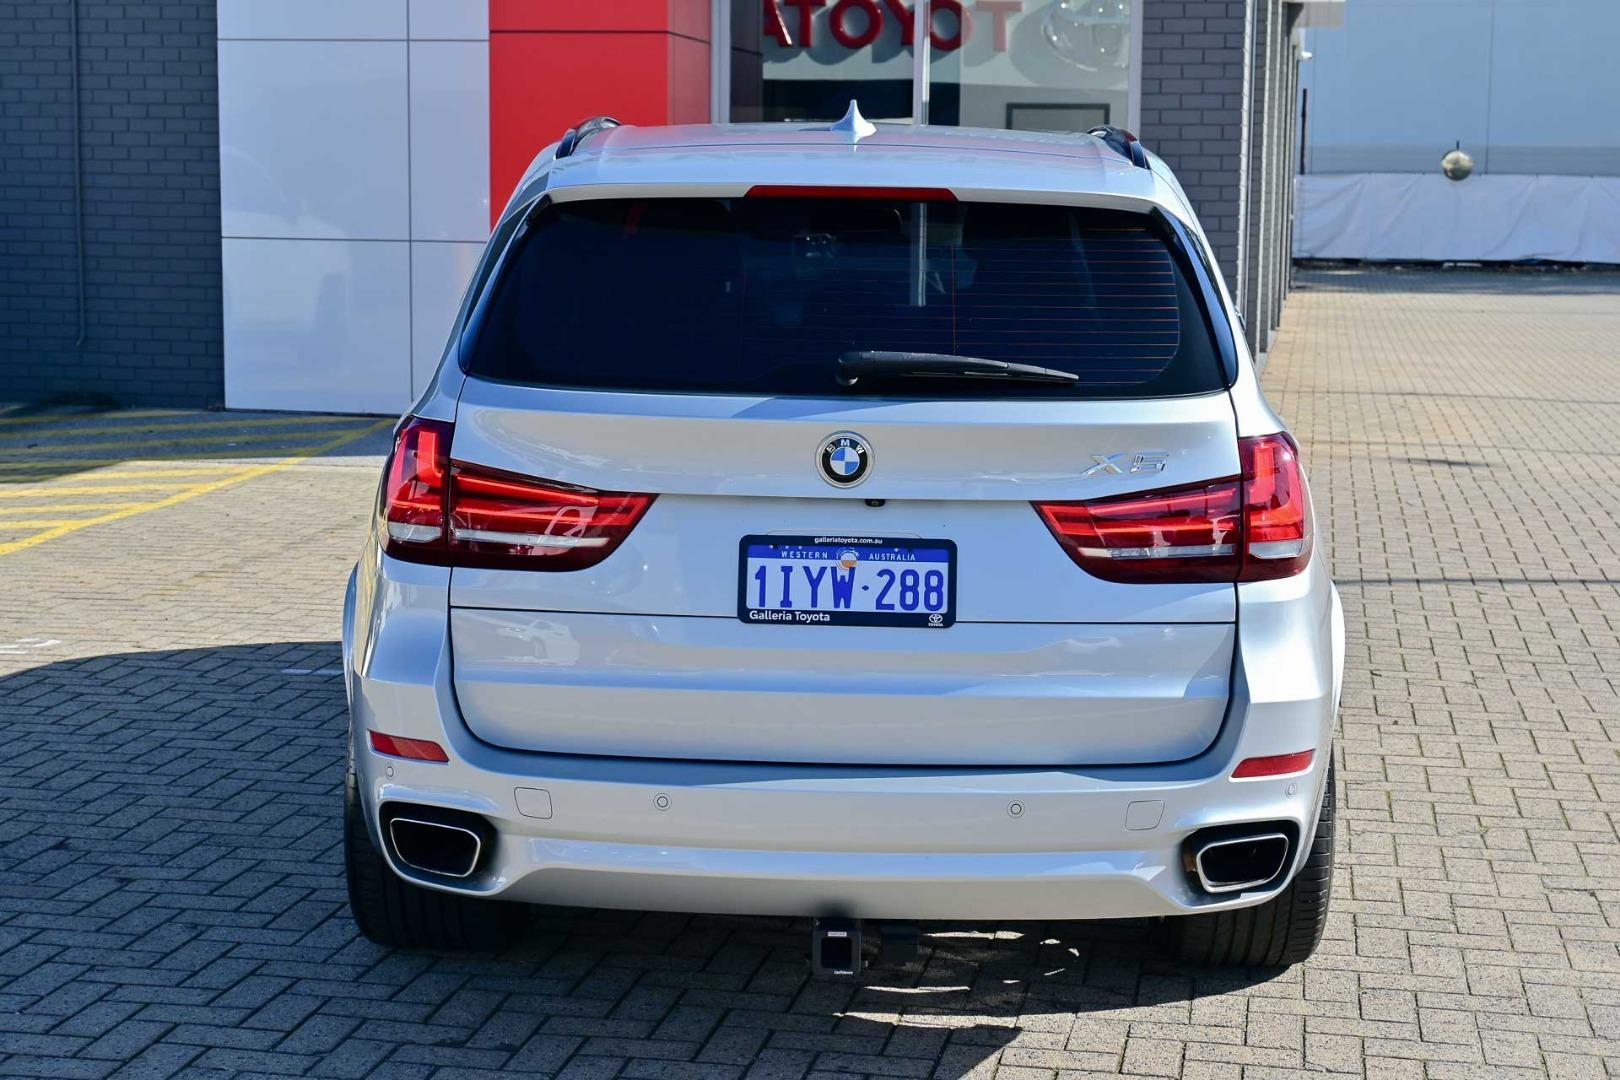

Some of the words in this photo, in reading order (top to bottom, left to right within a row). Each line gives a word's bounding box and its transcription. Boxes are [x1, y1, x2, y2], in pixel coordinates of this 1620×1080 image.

[826, 439, 864, 454] BMW
[1080, 452, 1169, 475] X5
[814, 536, 883, 544] galleriatoyota.com.au
[781, 550, 828, 559] WESTERN
[868, 553, 916, 561] AUSTRALIA
[749, 610, 792, 620] Galleria
[794, 611, 830, 623] Toyota
